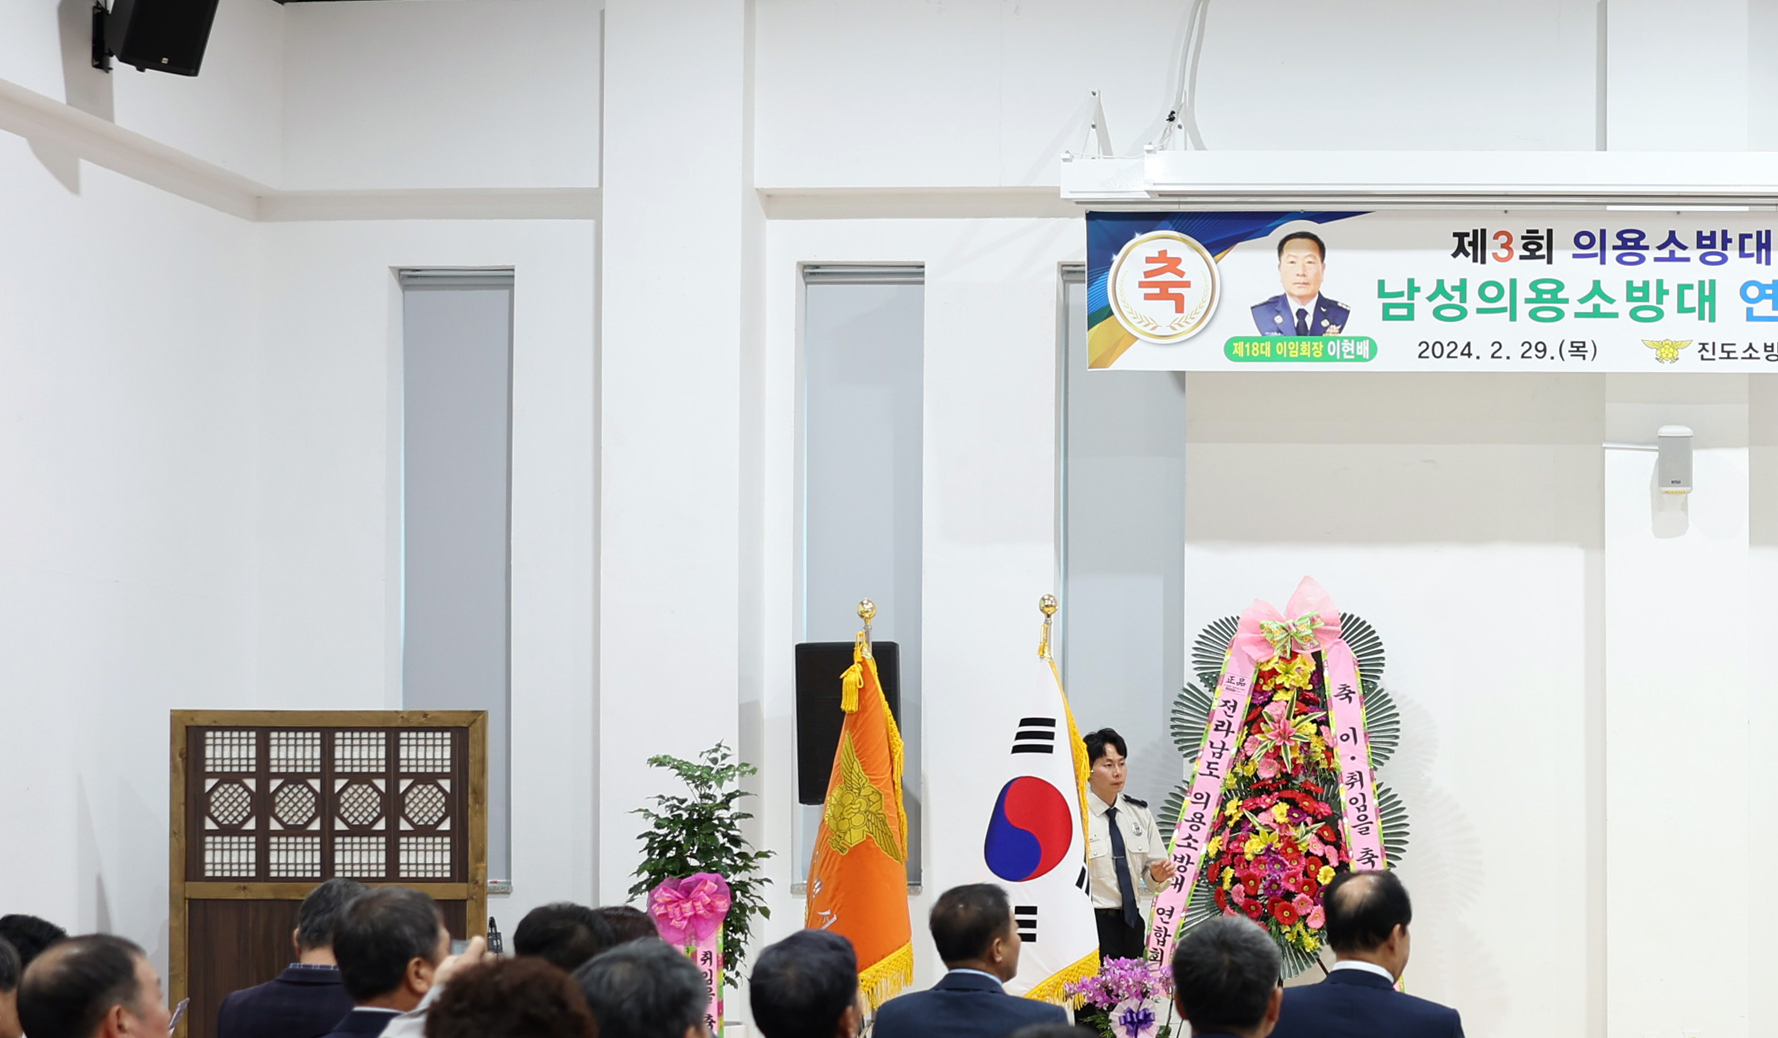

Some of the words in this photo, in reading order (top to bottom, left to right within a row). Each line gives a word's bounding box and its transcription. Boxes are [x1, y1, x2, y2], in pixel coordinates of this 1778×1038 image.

[1451, 228, 1554, 265] 제3회
[1138, 249, 1192, 315] 축
[1377, 277, 1717, 324] 남성의용소방대
[1231, 340, 1271, 359] 제18대
[1275, 340, 1324, 358] 이임회장
[1327, 339, 1371, 360] 이현배
[1417, 340, 1481, 360] 2024.
[1490, 340, 1511, 360] 2.
[1520, 338, 1598, 362] 29.(목)
[1333, 683, 1357, 705] 축
[1198, 699, 1239, 780] 전라남도
